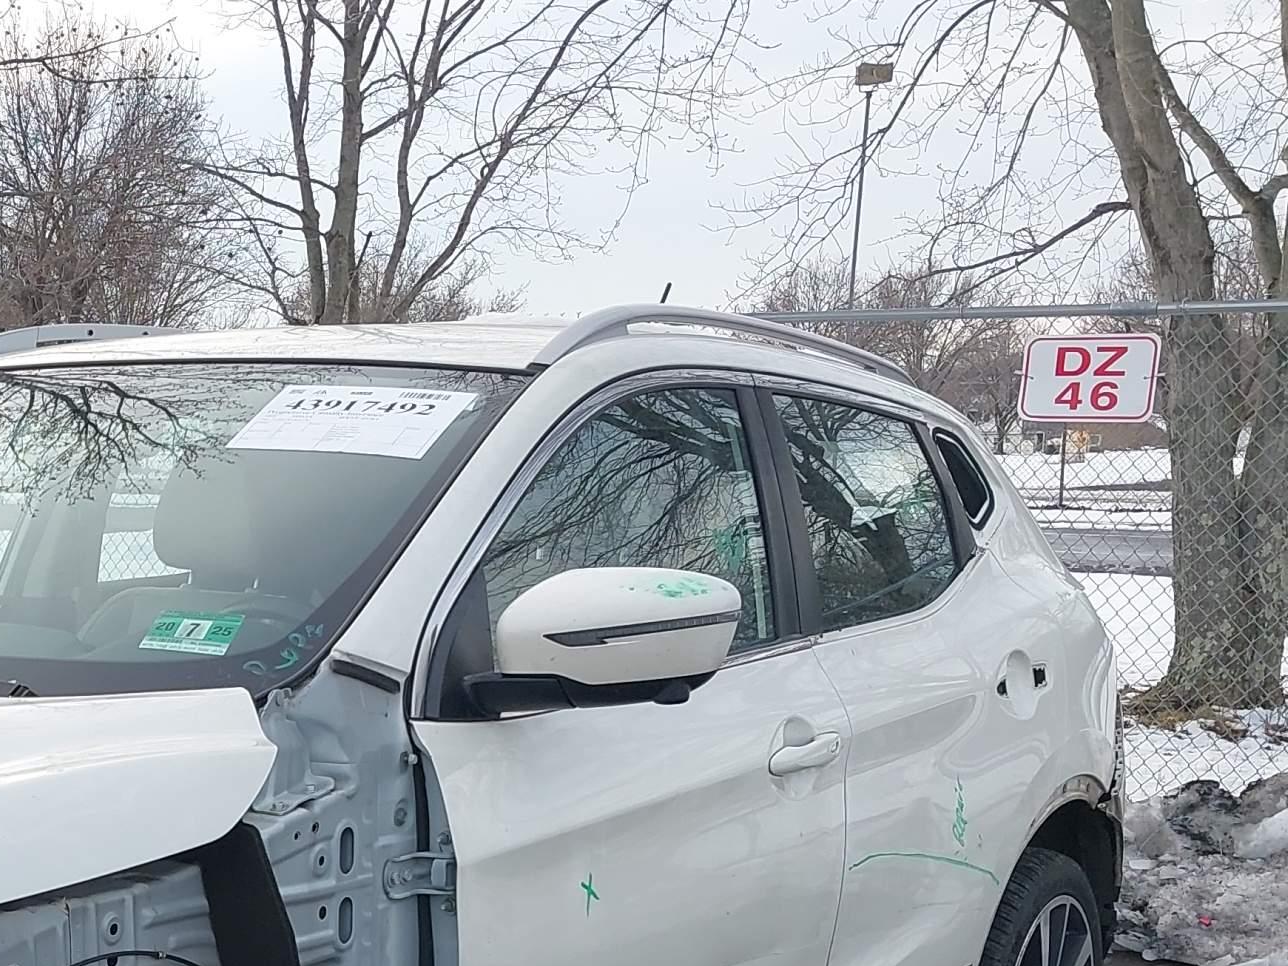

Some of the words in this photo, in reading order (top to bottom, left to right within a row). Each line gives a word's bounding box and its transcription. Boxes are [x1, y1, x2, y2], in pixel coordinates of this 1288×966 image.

[1055, 346, 1128, 376] DZ
[285, 398, 436, 416] 43917492
[1054, 381, 1119, 411] 46
[155, 622, 176, 632] 20
[185, 622, 201, 638] 7
[211, 626, 233, 636] 25
